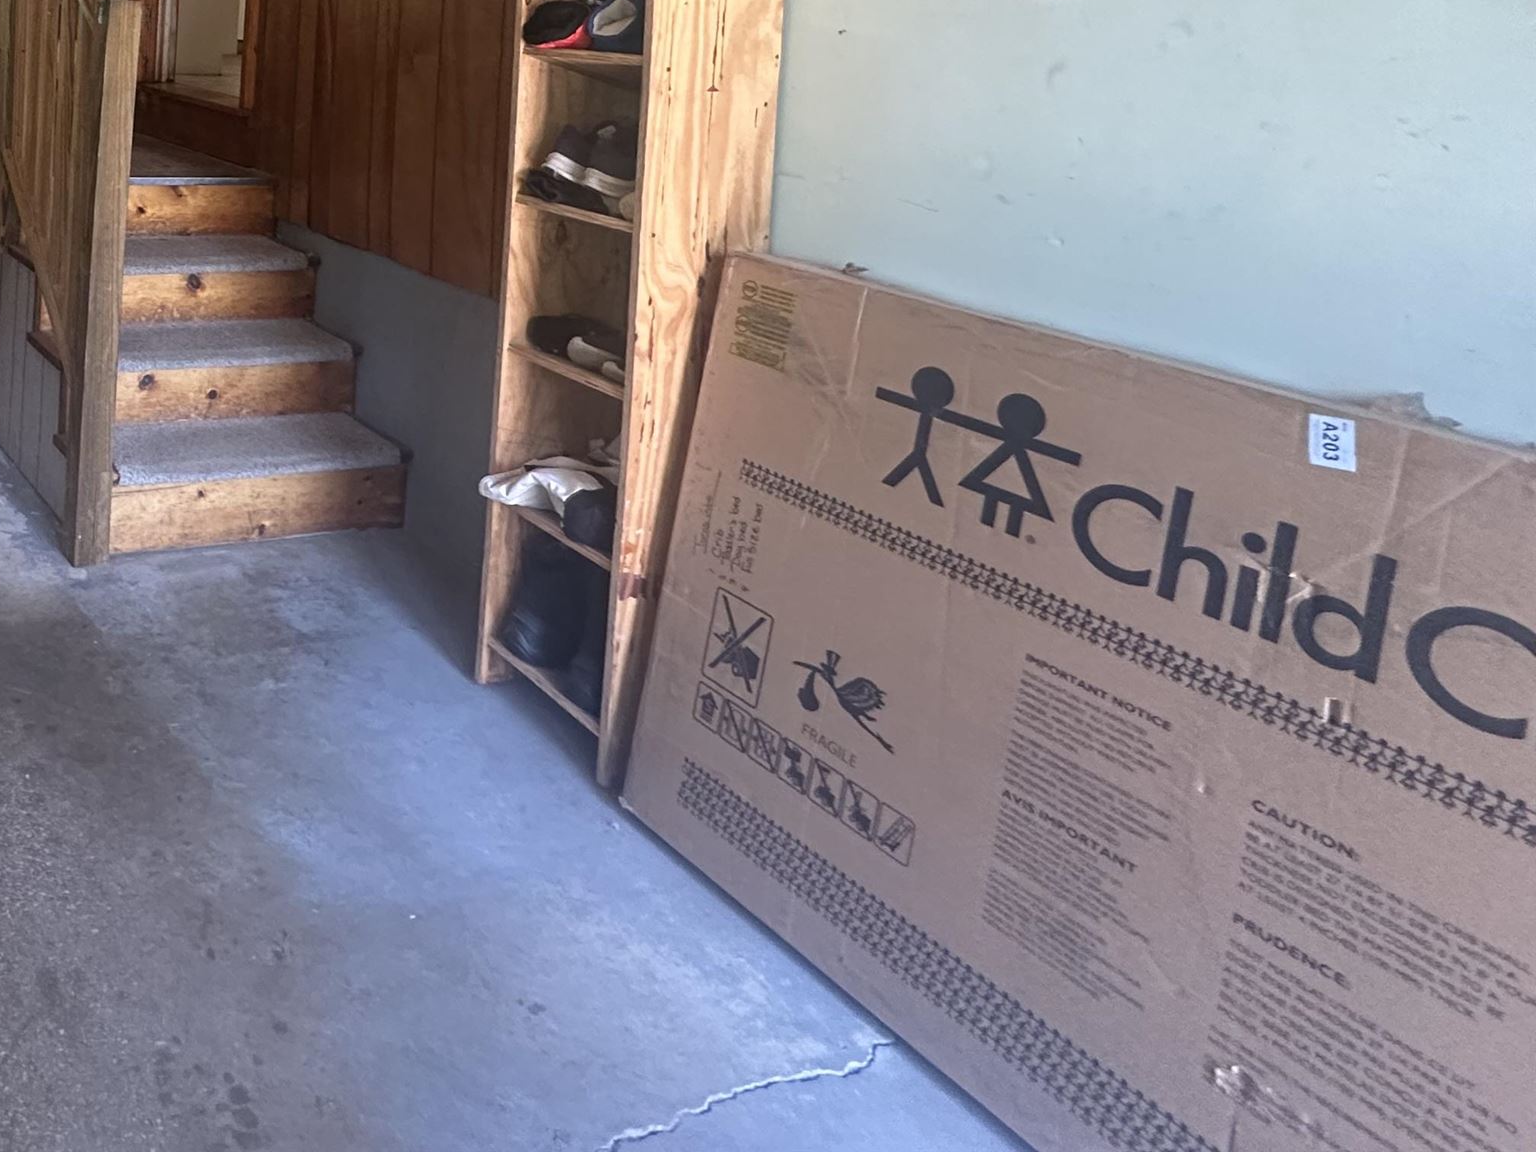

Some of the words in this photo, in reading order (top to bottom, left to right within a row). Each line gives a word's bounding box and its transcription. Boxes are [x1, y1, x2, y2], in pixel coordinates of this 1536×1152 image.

[1322, 421, 1340, 461] A203
[1072, 484, 1398, 684] Child
[1025, 653, 1108, 699] IMPORTANT
[1112, 696, 1172, 732] NOTICE
[801, 722, 857, 769] FRAGILE
[1001, 790, 1035, 814] AVIS
[1039, 810, 1138, 873] IMPORTANT
